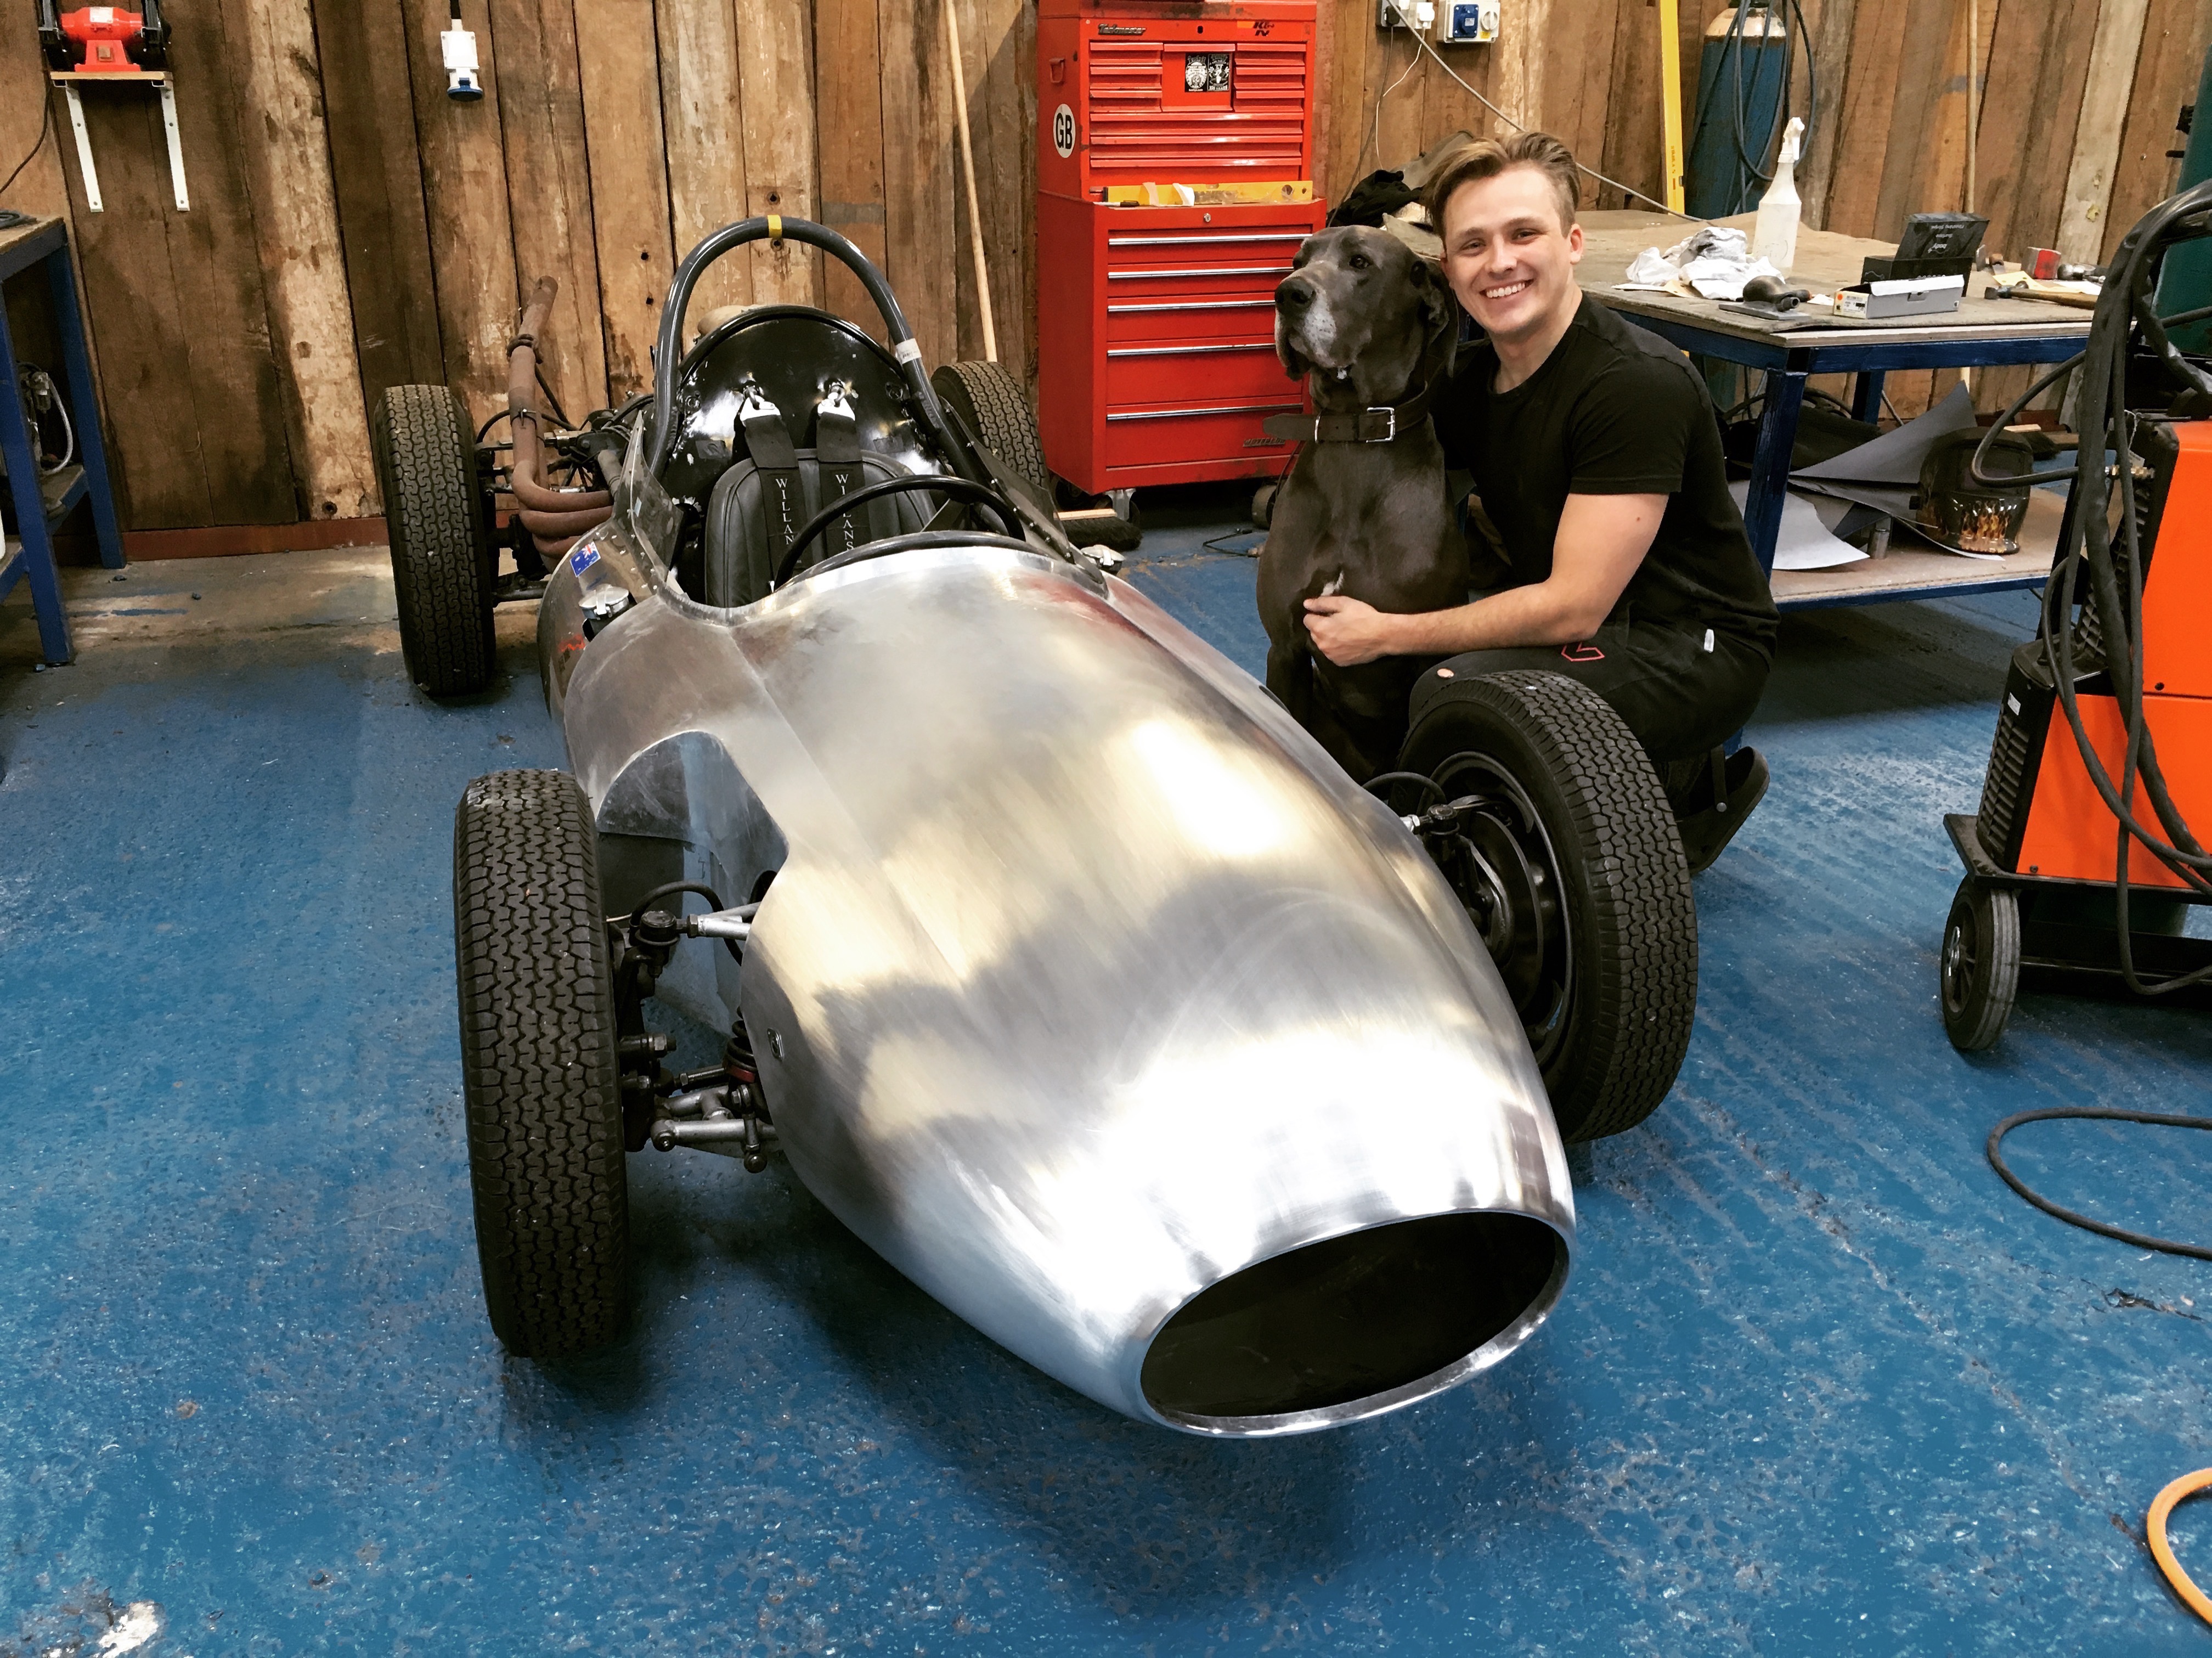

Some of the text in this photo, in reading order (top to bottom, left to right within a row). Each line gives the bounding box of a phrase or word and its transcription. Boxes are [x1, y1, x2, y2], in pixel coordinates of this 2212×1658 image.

[1098, 24, 1146, 35] Taskmaster
[1056, 112, 1073, 150] GB
[775, 478, 794, 545] WILLAN
[835, 474, 854, 551] WILANS
